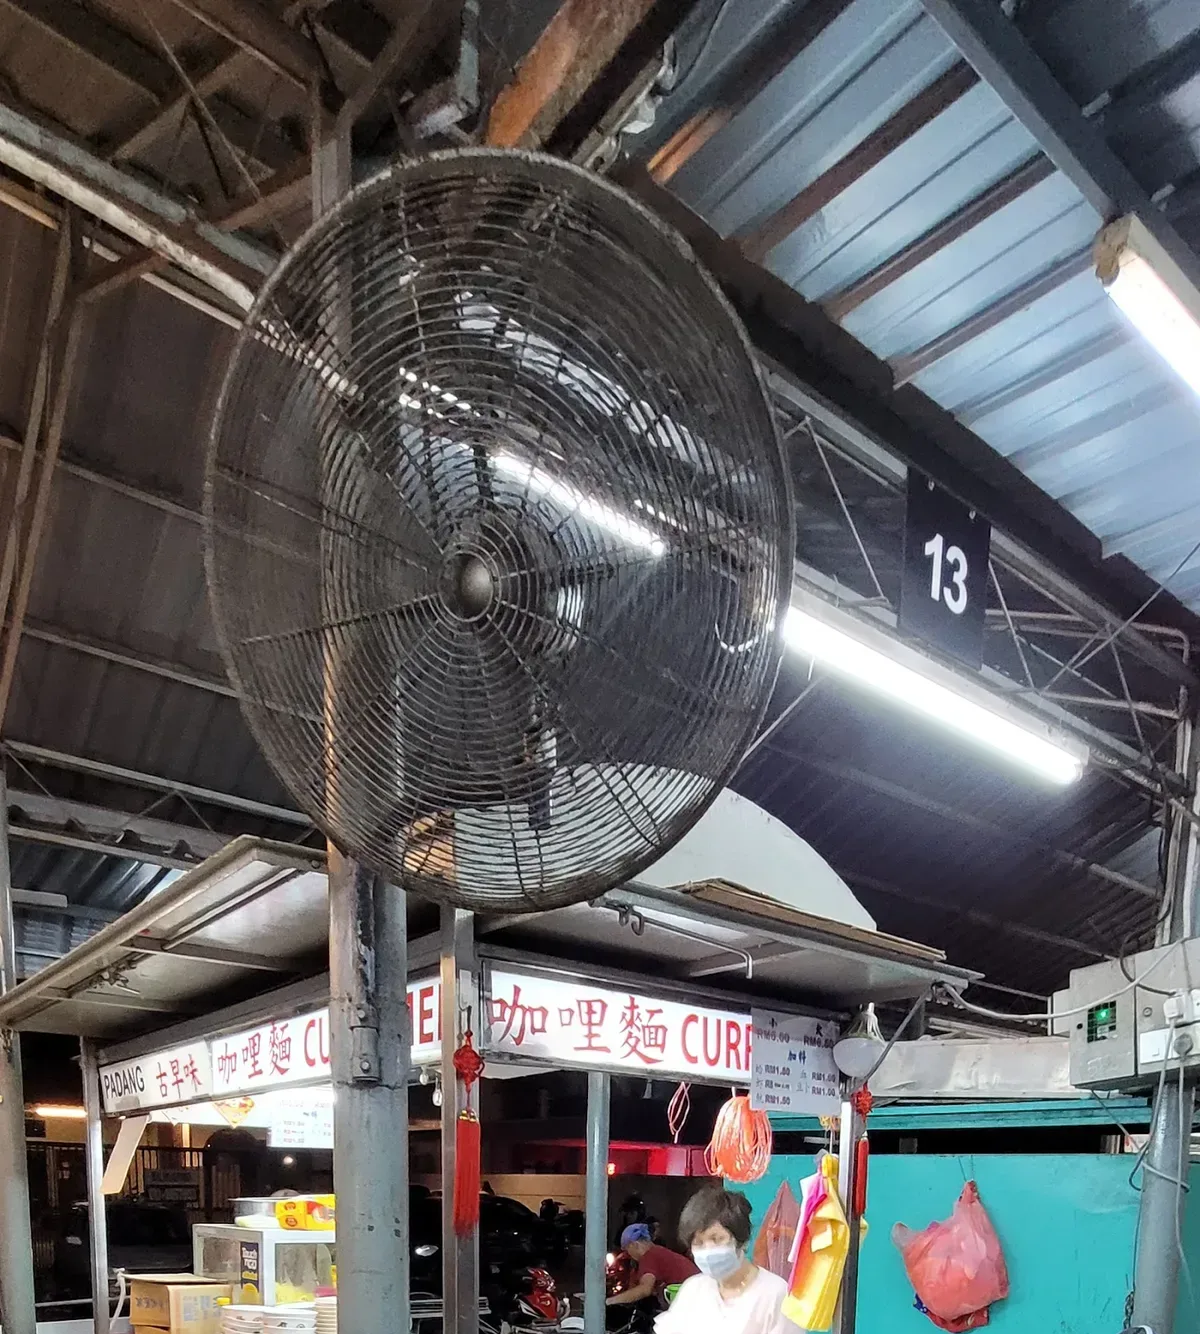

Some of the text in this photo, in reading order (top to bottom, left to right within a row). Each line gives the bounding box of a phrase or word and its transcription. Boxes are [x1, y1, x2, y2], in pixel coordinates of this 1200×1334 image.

[925, 533, 967, 614] 13
[217, 1020, 292, 1084] 咖哩麵
[487, 984, 668, 1064] 咖哩麵
[103, 1066, 145, 1100] PADANG
[155, 1053, 202, 1099] 古早味
